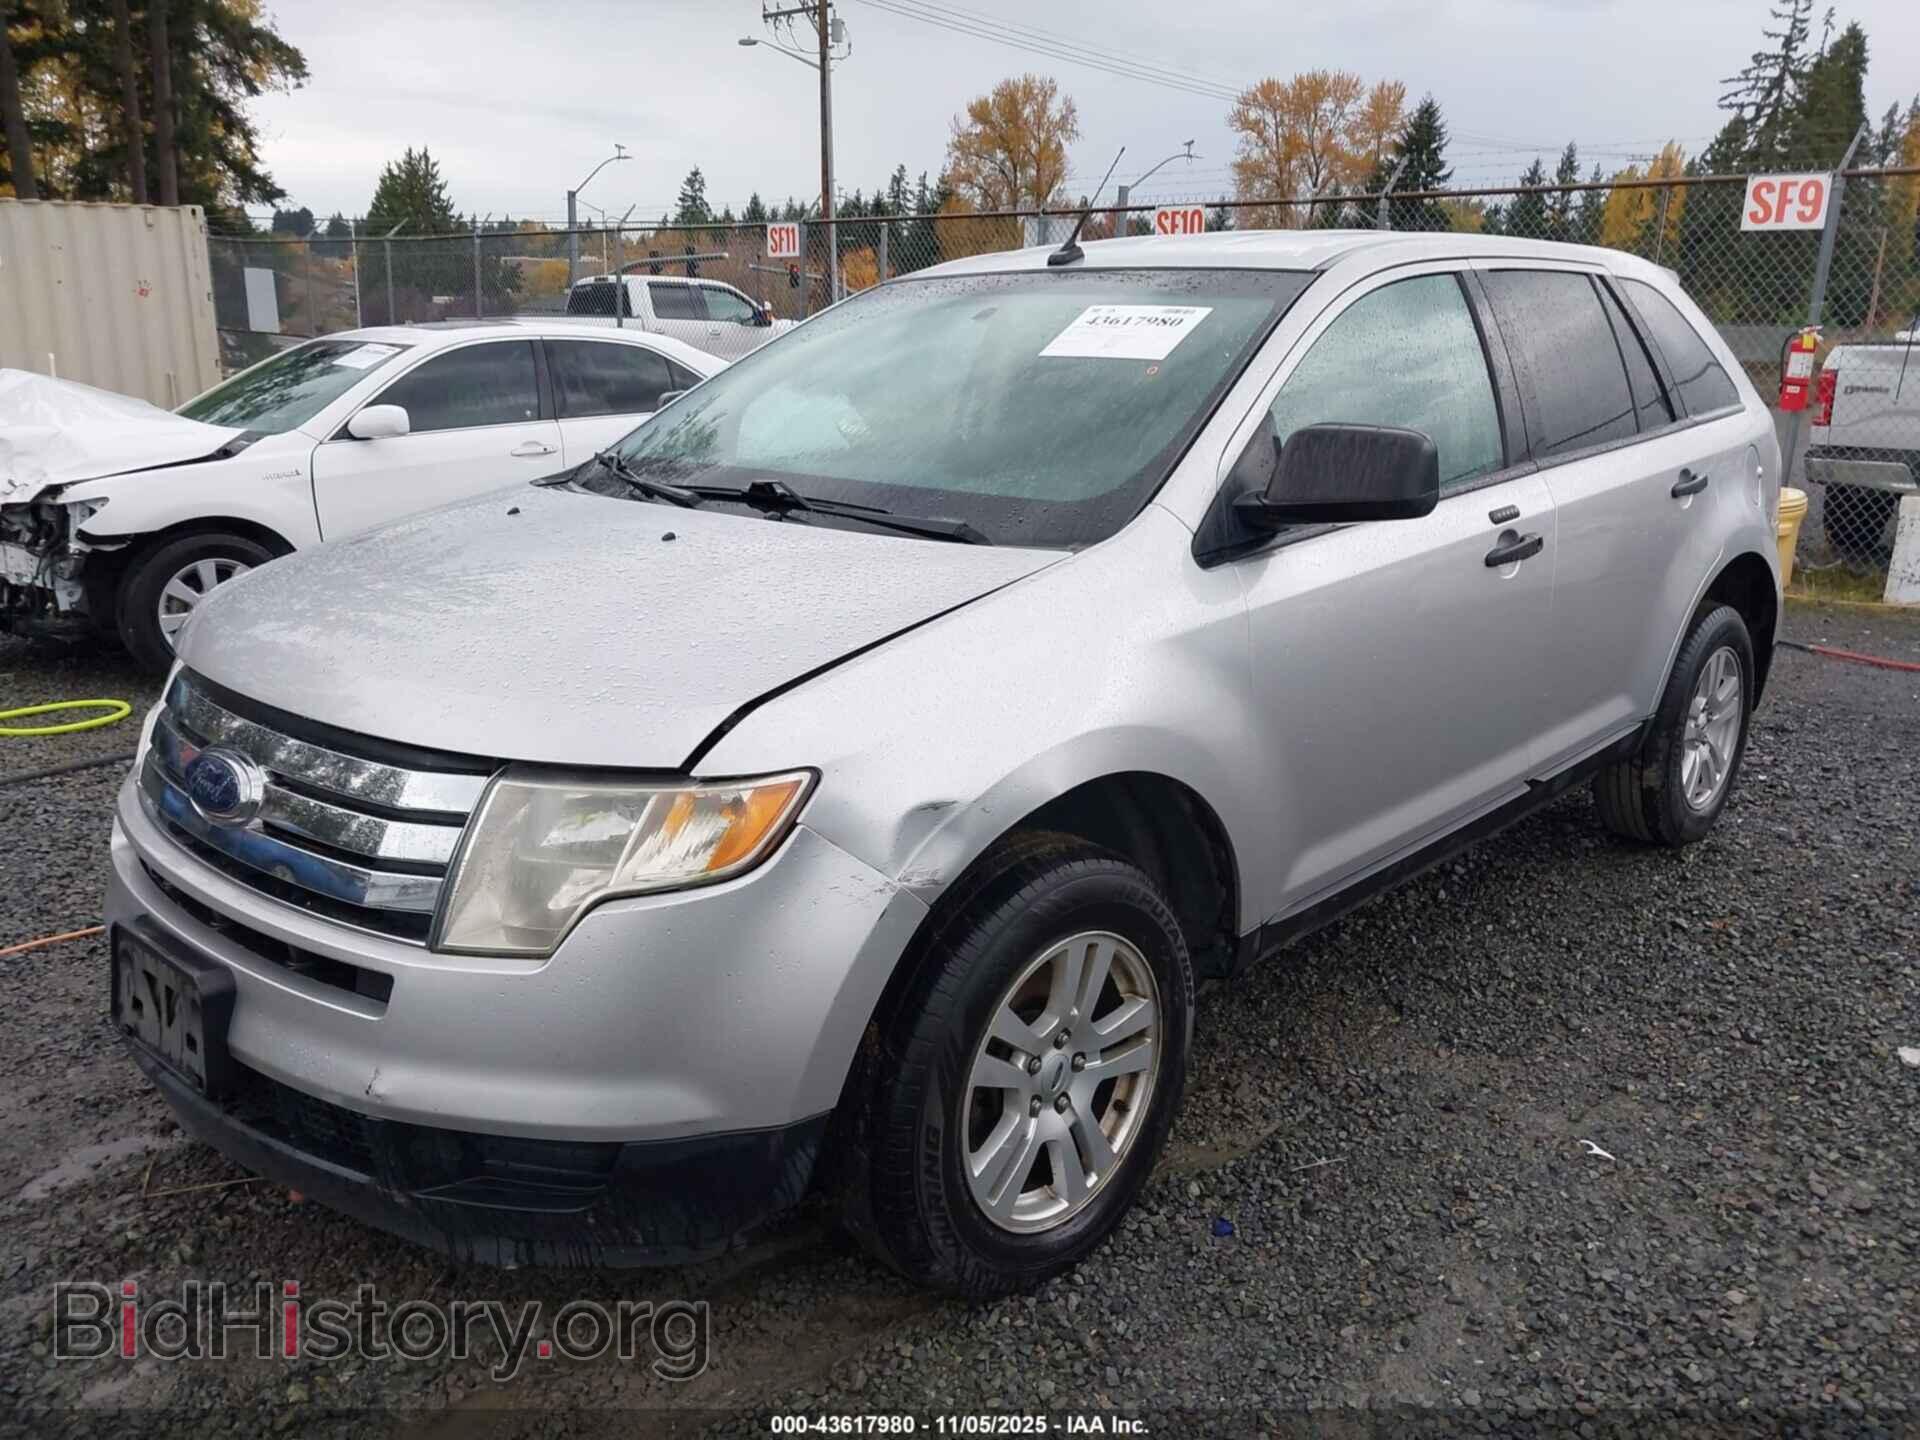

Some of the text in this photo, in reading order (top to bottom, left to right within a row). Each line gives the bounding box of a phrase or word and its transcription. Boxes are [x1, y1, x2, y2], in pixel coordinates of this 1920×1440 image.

[1748, 180, 1824, 225] SF9
[1157, 210, 1203, 234] SF10
[770, 226, 796, 253] SF11
